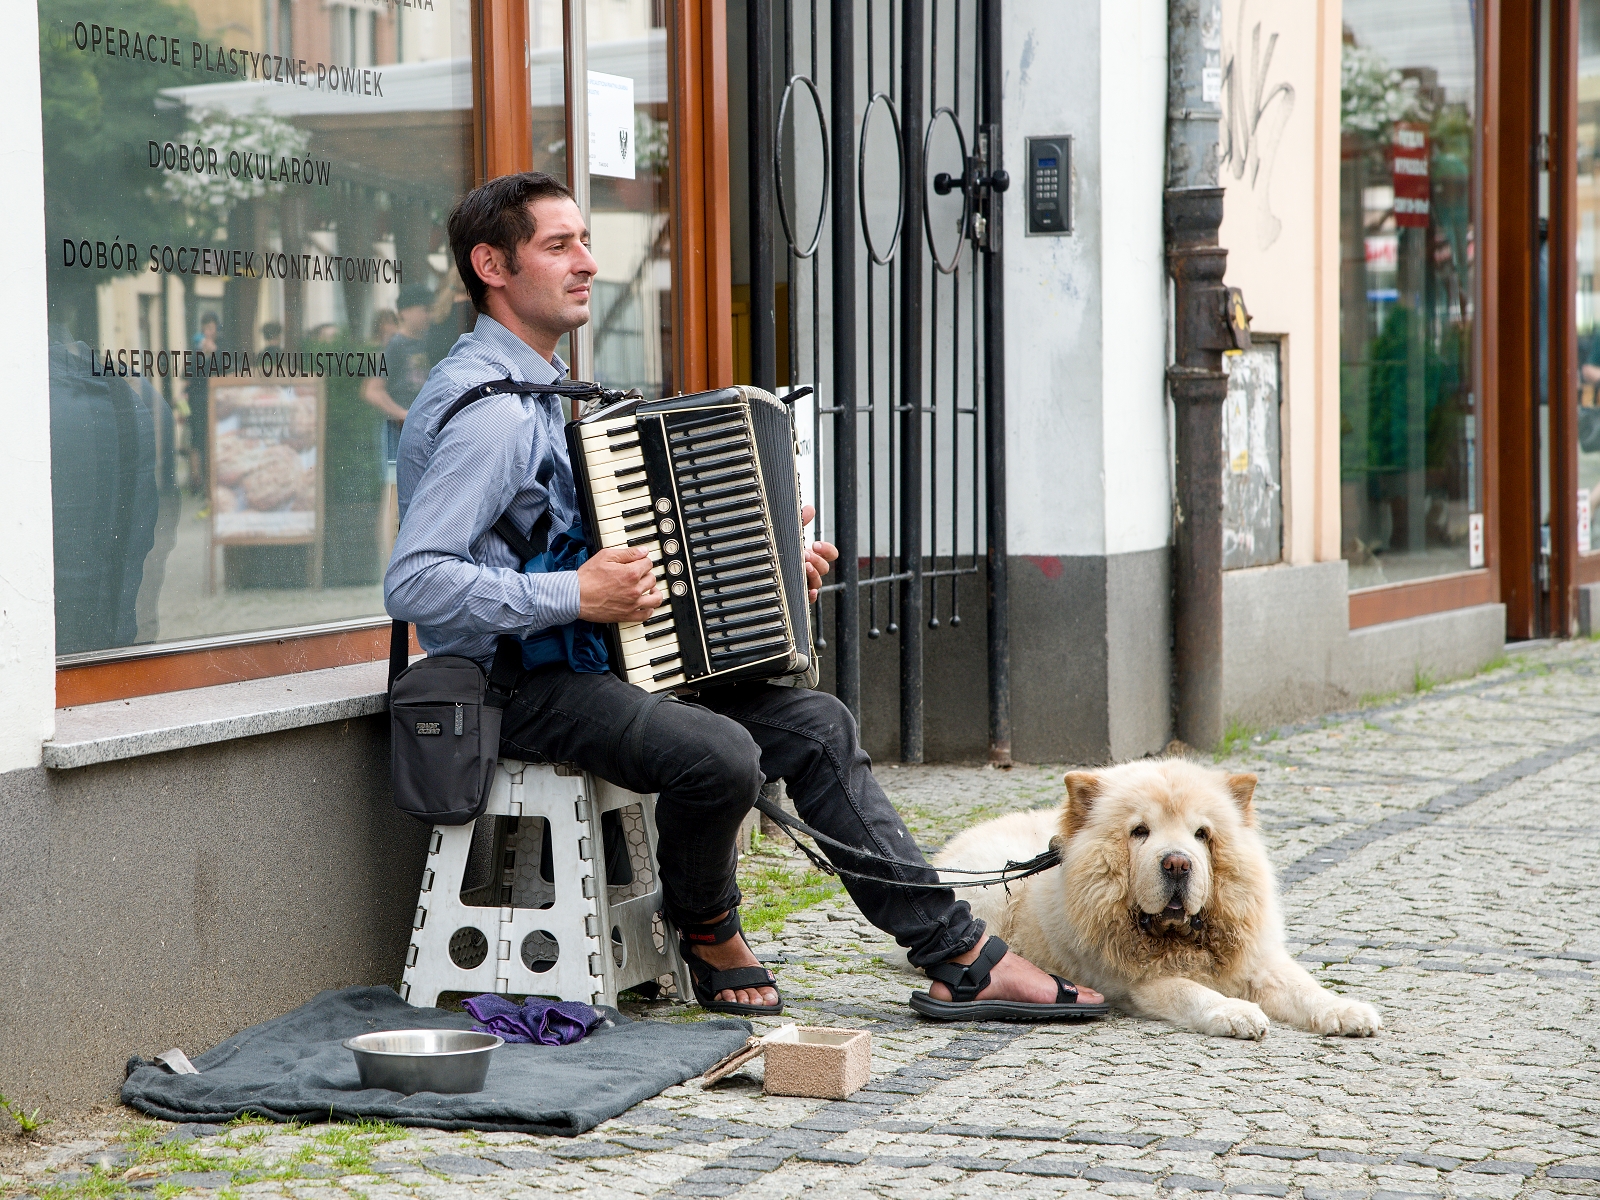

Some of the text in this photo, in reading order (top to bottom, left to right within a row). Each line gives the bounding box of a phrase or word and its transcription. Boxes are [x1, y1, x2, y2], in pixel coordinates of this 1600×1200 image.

[74, 21, 384, 98] OPERACJE PLASTYCZNE POWIEK
[148, 139, 331, 187] DOBÓR OKULARÓW
[63, 235, 403, 284] DOBÓR SOCZEWEK KONTAKTOWYCH
[91, 348, 389, 378] LASEROTERAPIA OKULISTYCZNA
